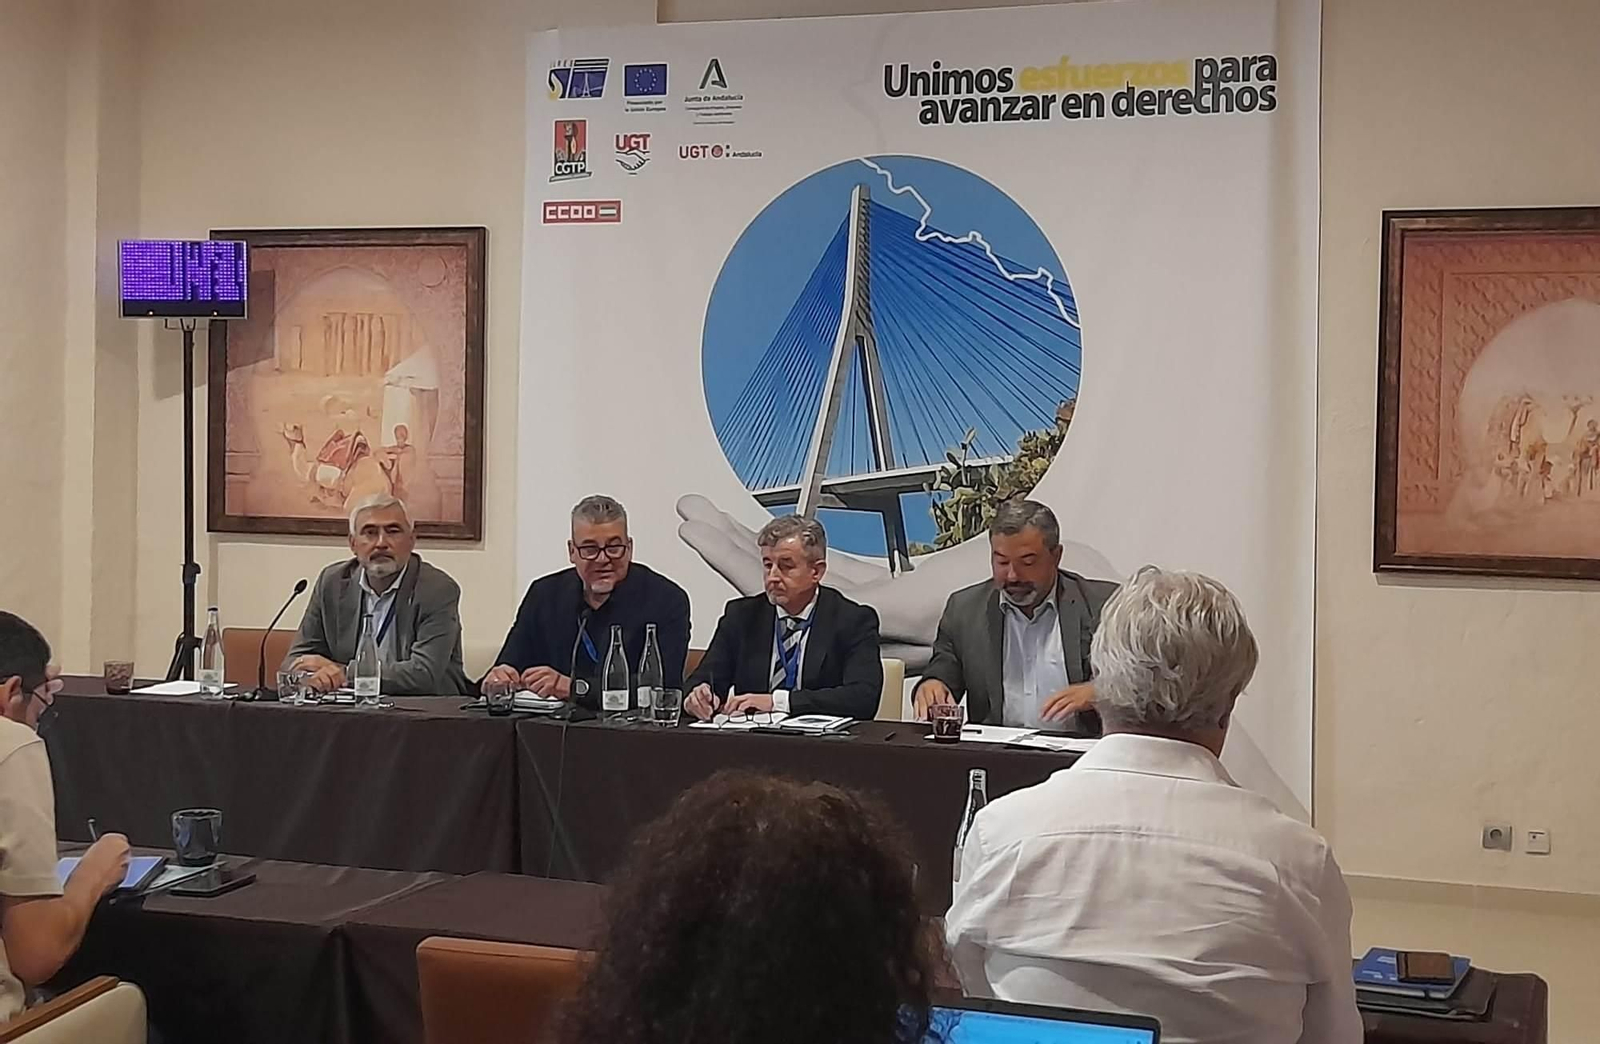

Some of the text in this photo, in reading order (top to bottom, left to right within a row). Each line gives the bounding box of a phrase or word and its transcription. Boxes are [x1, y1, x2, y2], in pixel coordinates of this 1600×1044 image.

[884, 55, 1277, 98] Unimos esfuerzos para
[919, 80, 1277, 125] avanzar en derechos
[615, 133, 651, 150] UGT
[679, 145, 709, 159] UGT
[555, 161, 586, 175] CGTP
[545, 205, 596, 219] CCOO
